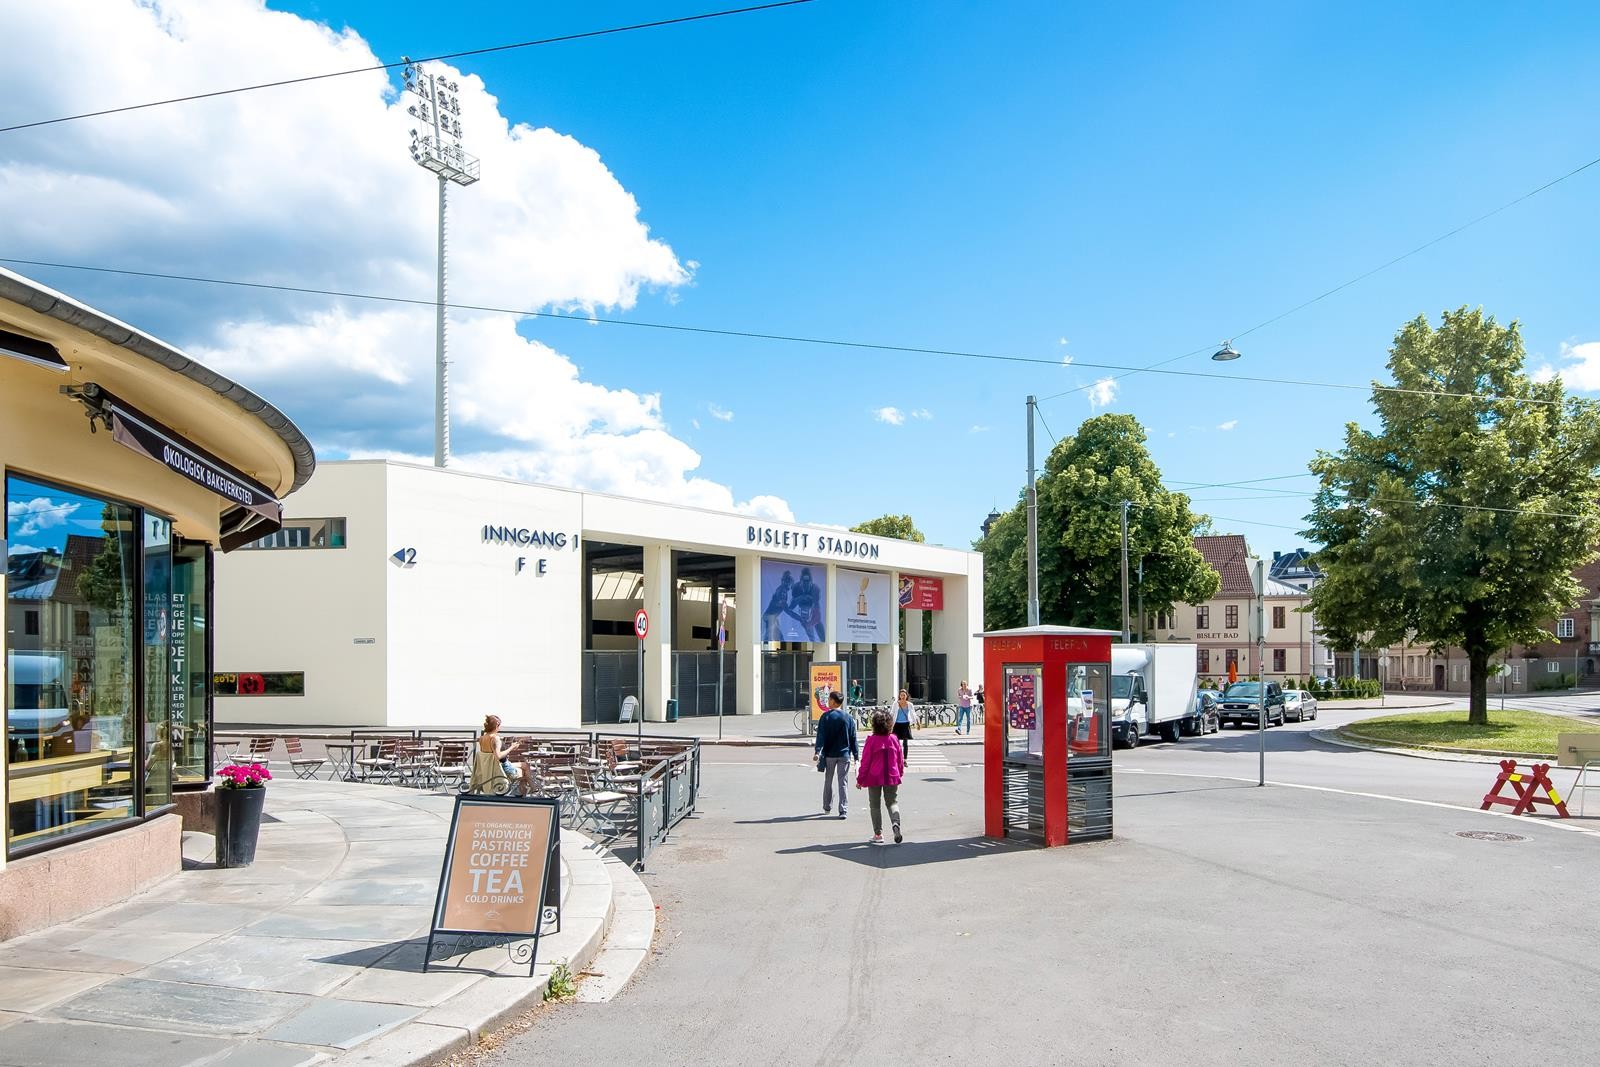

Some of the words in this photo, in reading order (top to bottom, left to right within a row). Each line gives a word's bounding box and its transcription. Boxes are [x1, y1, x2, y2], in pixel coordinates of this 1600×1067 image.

[164, 445, 205, 482] ØKOLOGISK
[206, 470, 252, 505] BAKEVERKSTED
[483, 525, 566, 548] INNGANG
[573, 534, 579, 548] 1
[748, 526, 808, 548] BISLETT
[818, 536, 880, 558] STADION
[405, 548, 417, 564] 2
[518, 556, 526, 572] F
[538, 558, 547, 574] E
[638, 617, 646, 631] 40
[473, 829, 532, 839] SANDWICH
[472, 840, 530, 852] PASTRIES
[470, 853, 528, 867] COFFEE
[468, 868, 524, 894] TEA
[465, 894, 488, 903] COLD
[491, 895, 524, 904] DRINKS
